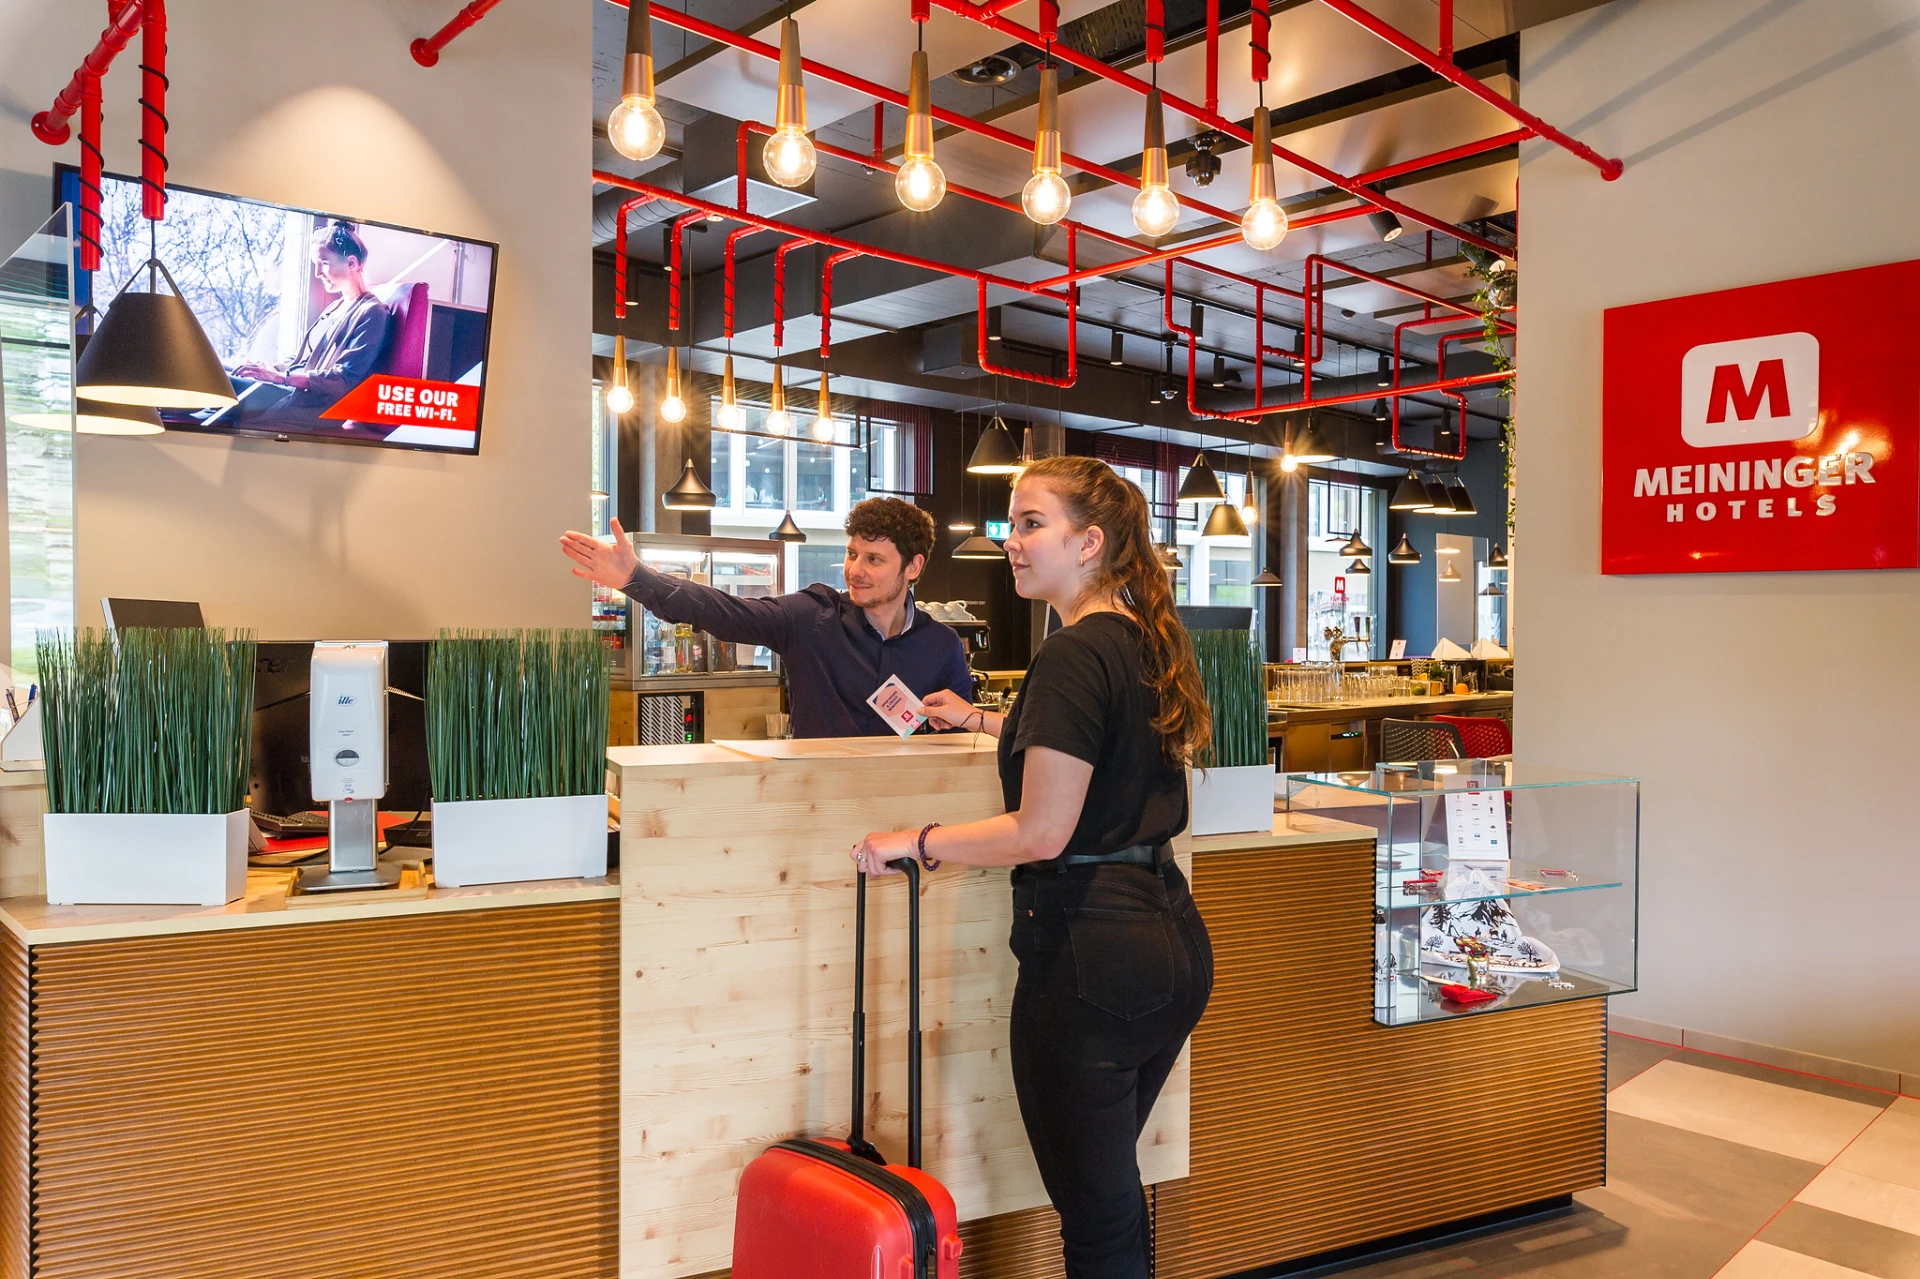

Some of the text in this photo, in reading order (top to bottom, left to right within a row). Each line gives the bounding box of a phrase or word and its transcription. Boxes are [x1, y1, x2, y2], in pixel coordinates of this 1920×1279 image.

[378, 384, 459, 407] USE OUR
[1706, 358, 1791, 424] M
[377, 401, 457, 422] FREE WI-FI.
[1633, 451, 1877, 497] MEININGER
[1666, 494, 1837, 523] HOTELS
